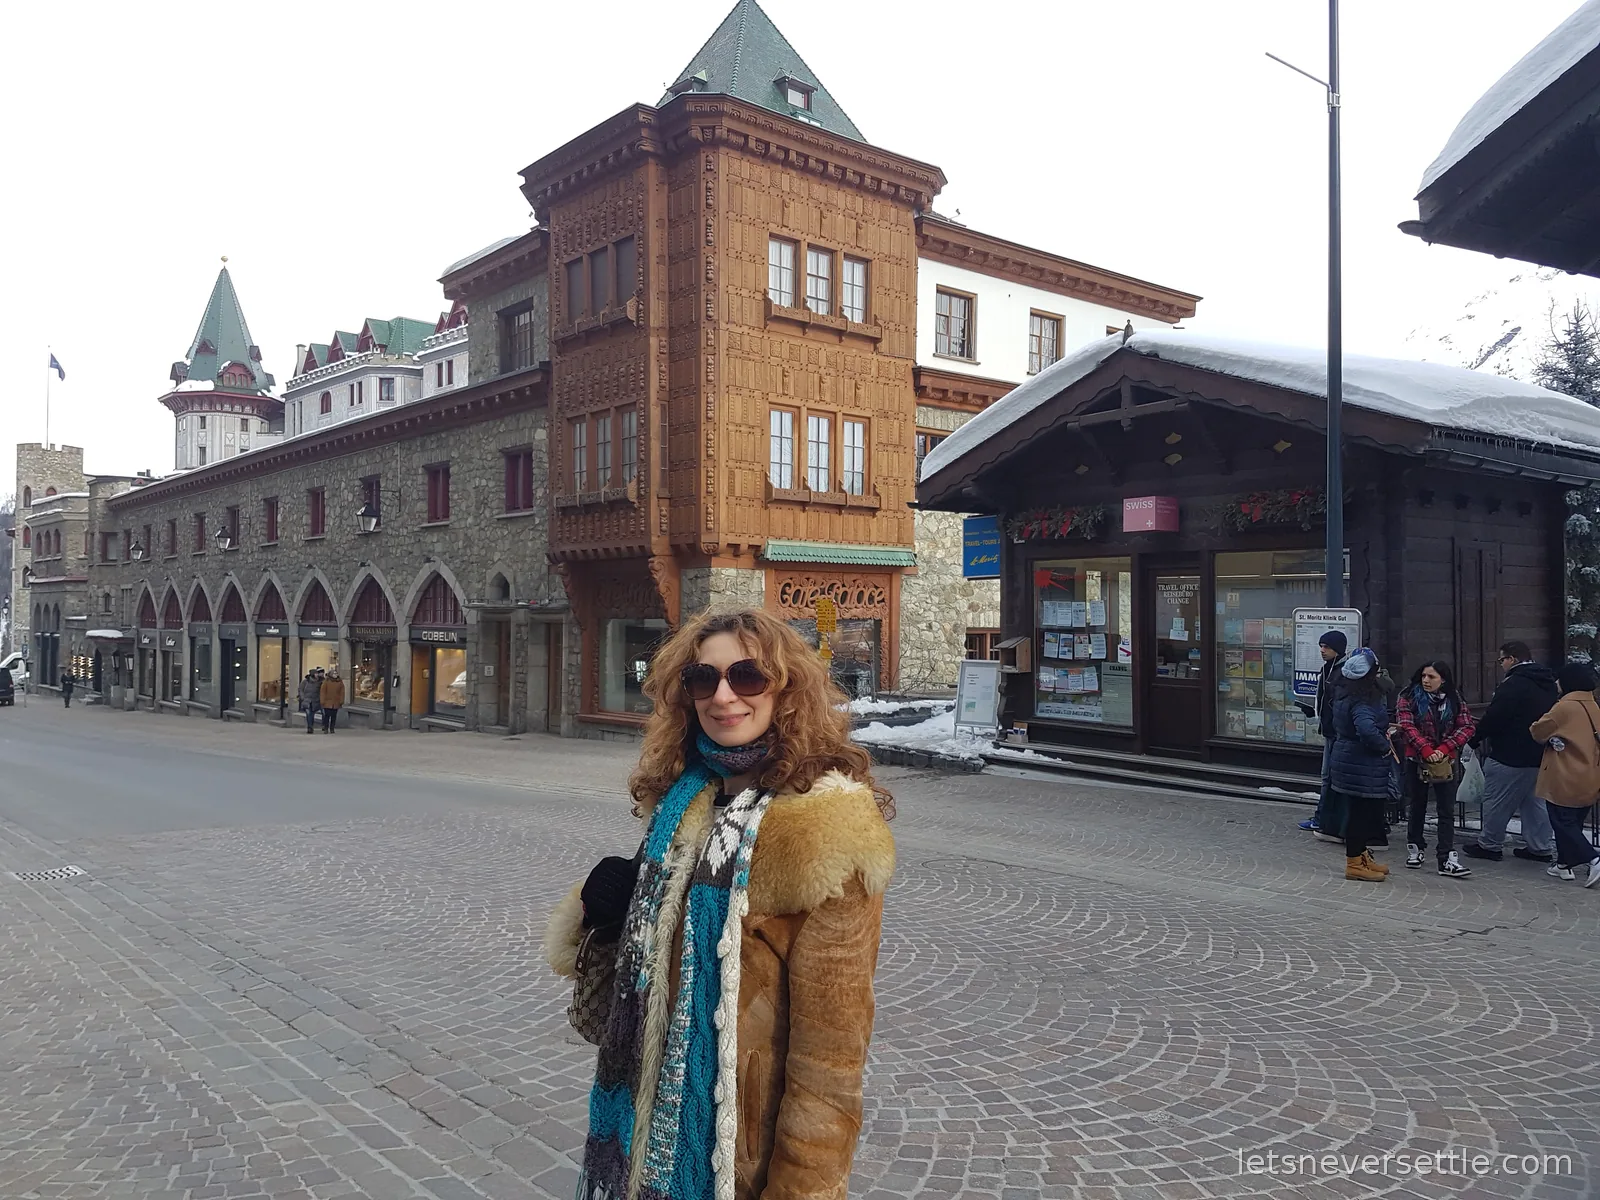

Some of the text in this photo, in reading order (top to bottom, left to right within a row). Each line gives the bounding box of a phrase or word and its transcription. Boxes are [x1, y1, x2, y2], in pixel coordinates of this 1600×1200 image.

[779, 579, 886, 609] Café Palace
[1179, 583, 1199, 591] OFFICE
